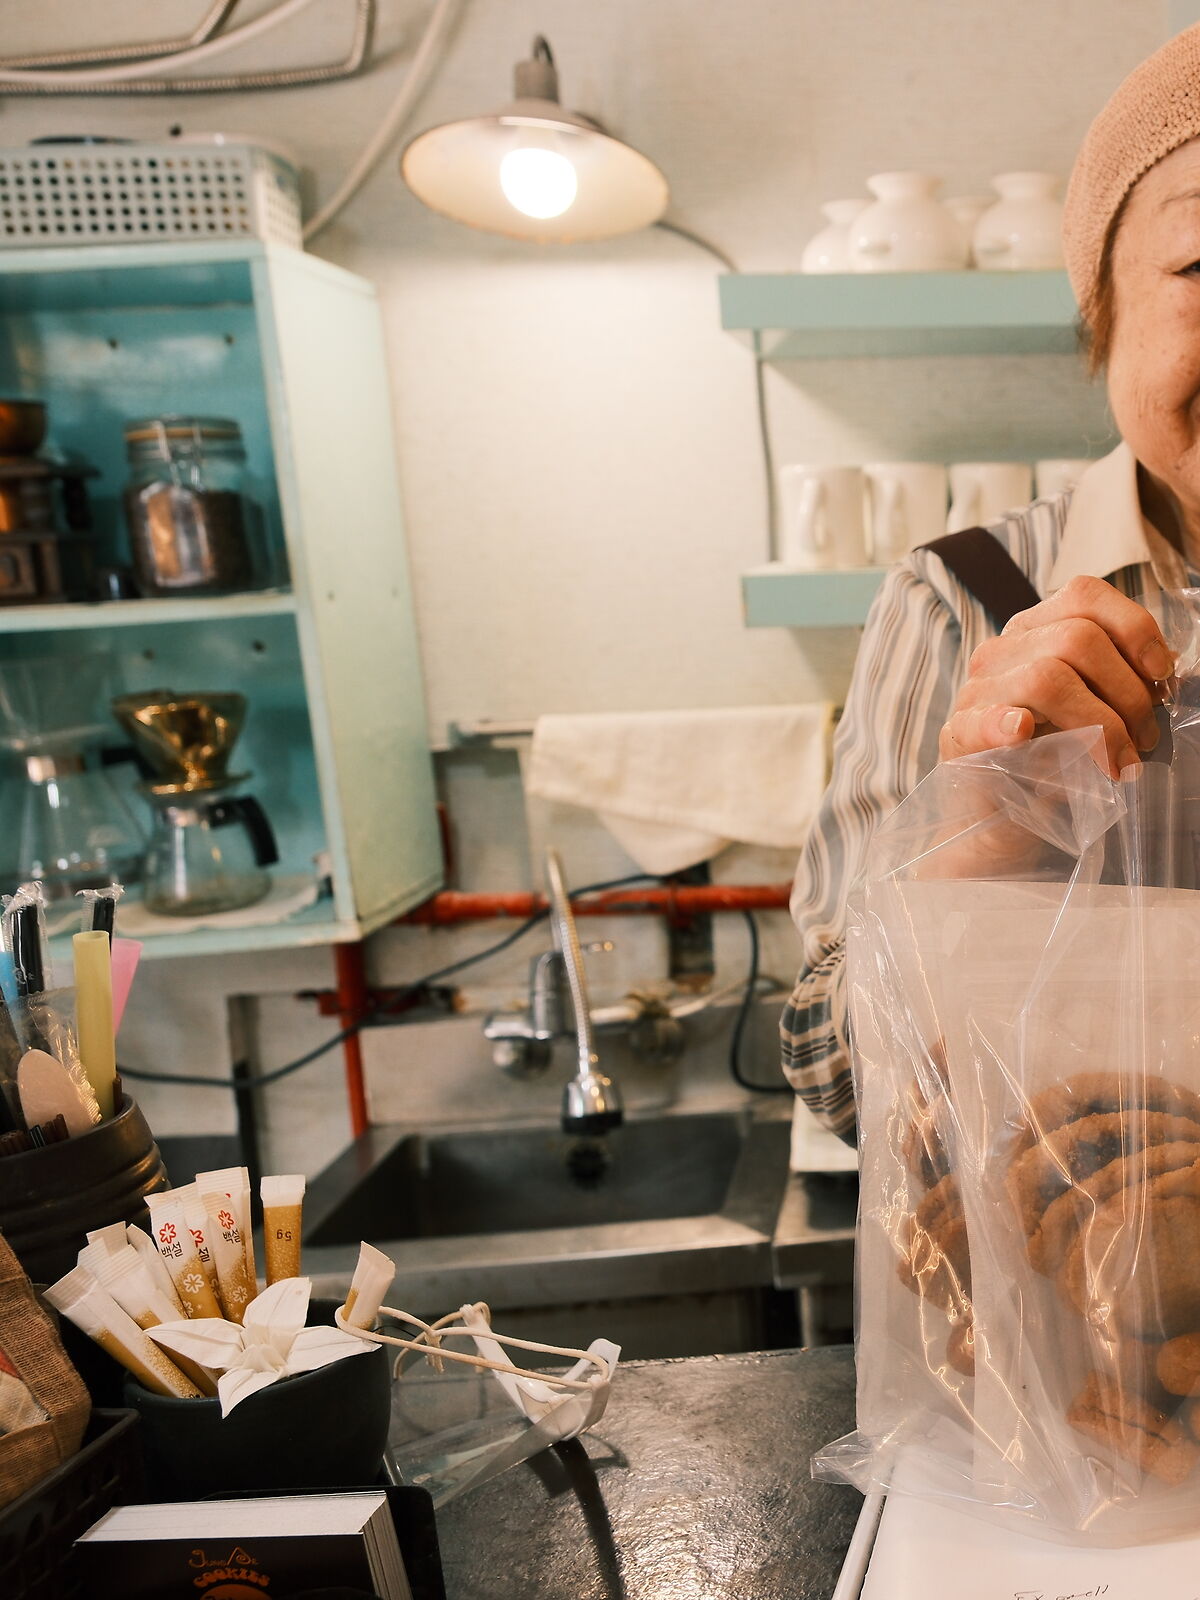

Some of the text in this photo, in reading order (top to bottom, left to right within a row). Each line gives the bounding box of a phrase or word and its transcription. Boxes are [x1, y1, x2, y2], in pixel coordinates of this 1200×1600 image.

[222, 1229, 241, 1243] 백설
[276, 1229, 292, 1241] 5g
[161, 1241, 183, 1260] 백설
[198, 1247, 210, 1263] 설
[193, 1567, 270, 1588] COOKIES
